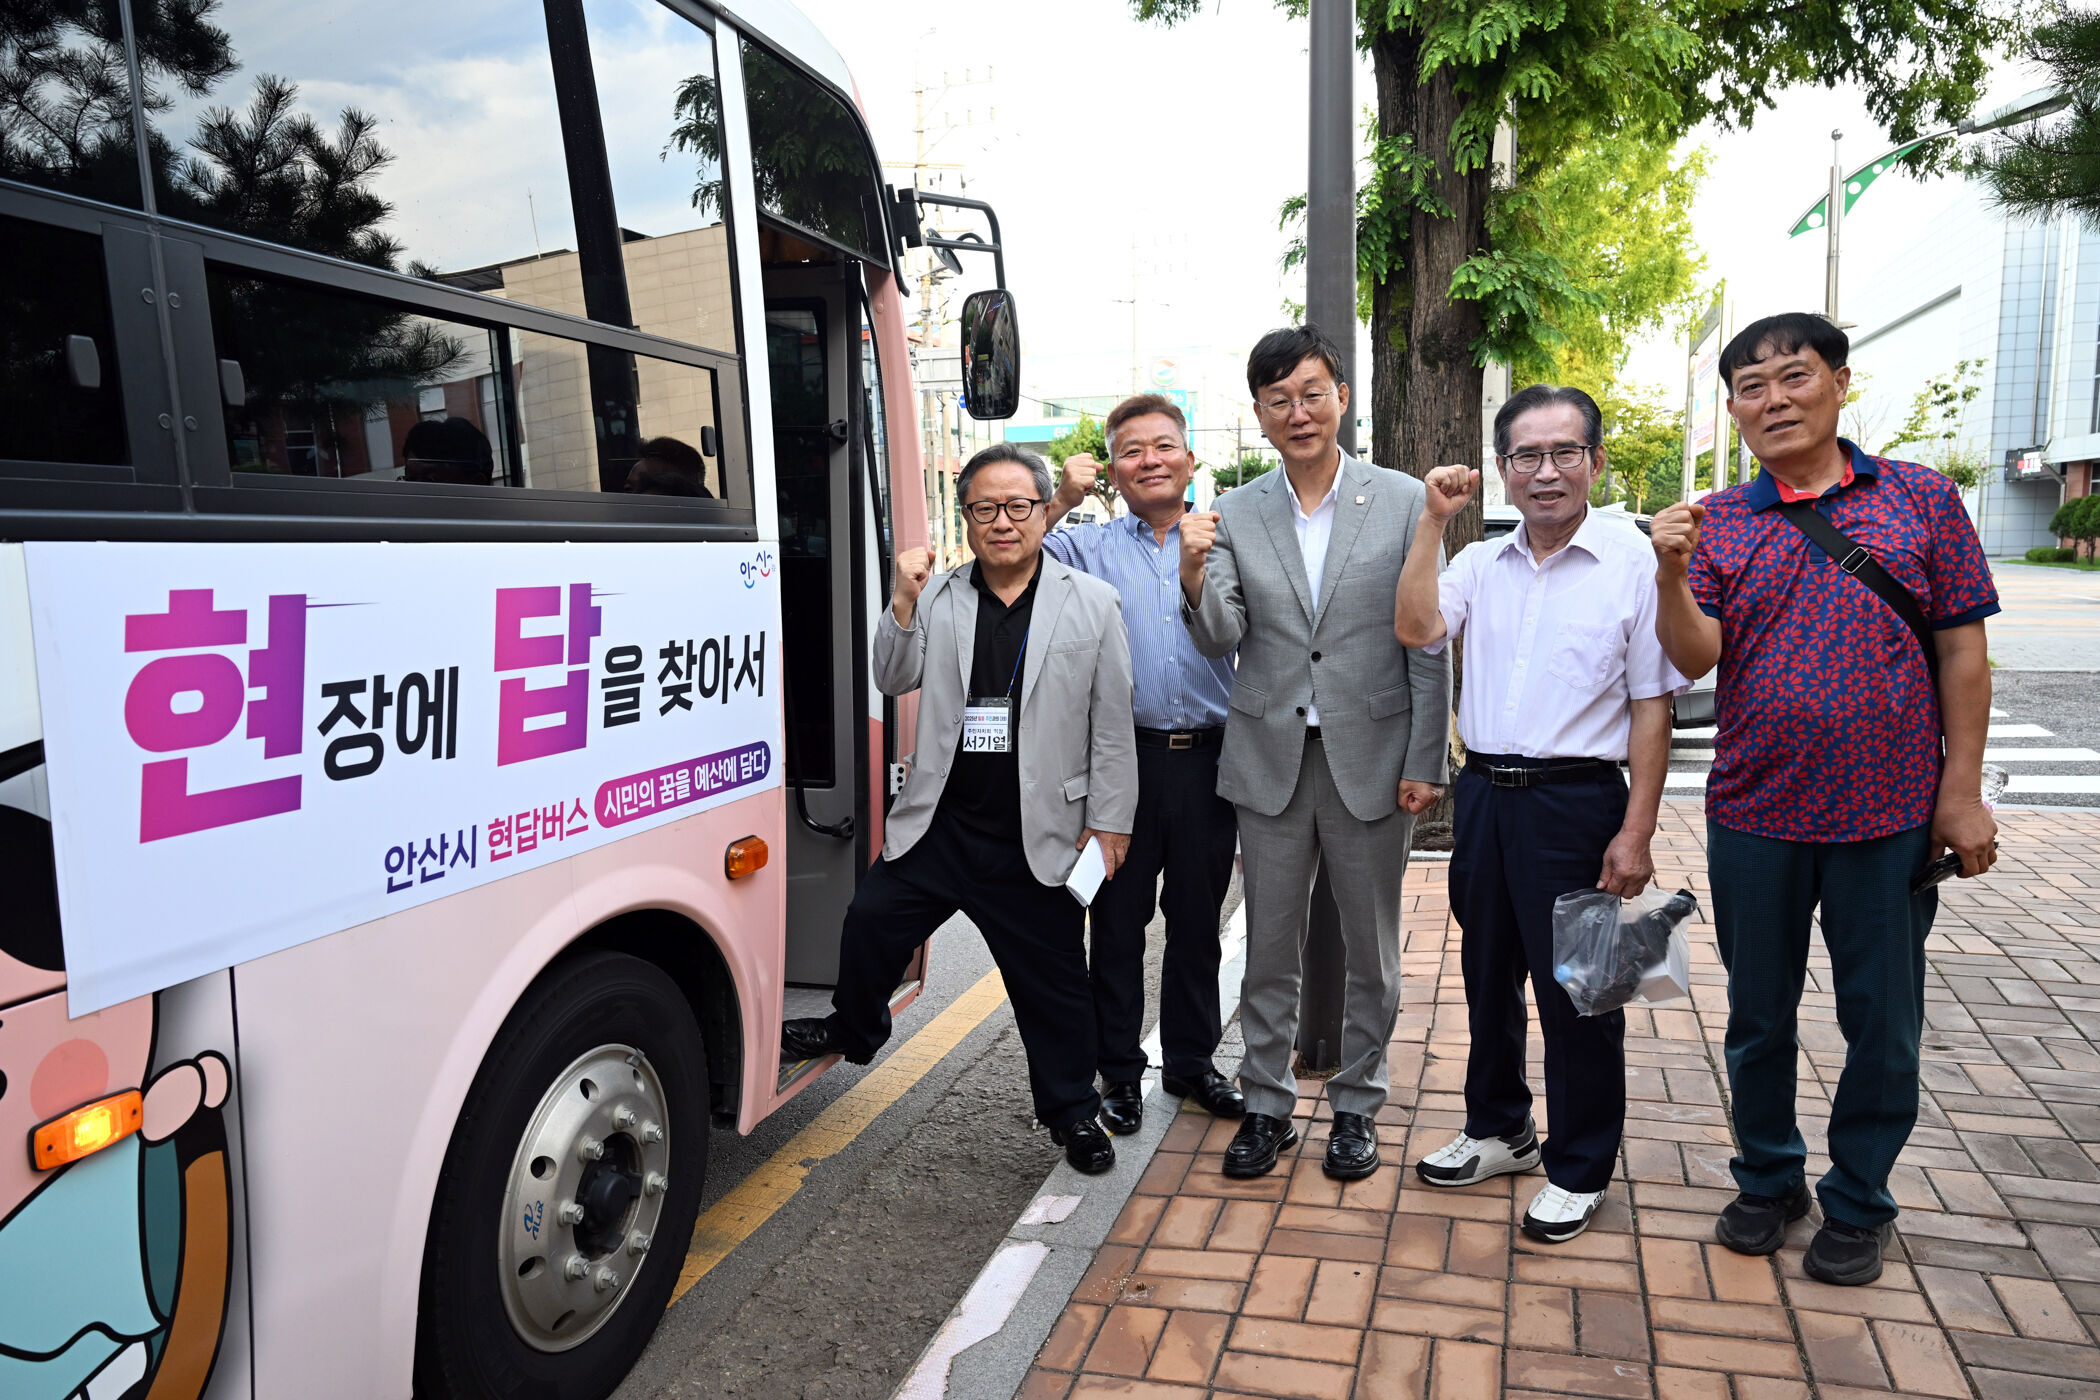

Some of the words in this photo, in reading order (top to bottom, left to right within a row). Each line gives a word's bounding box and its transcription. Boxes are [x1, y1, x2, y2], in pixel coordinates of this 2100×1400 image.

[124, 589, 460, 844] 현장에
[494, 583, 645, 766] 답을
[657, 631, 767, 718] 찾아서
[964, 735, 1006, 750] 서기열
[384, 824, 478, 894] 안산시
[487, 797, 589, 862] 현답버스
[603, 778, 655, 819] 시민의
[658, 768, 691, 806] 꿈을
[694, 759, 738, 792] 예산에
[739, 748, 767, 780] 담다
